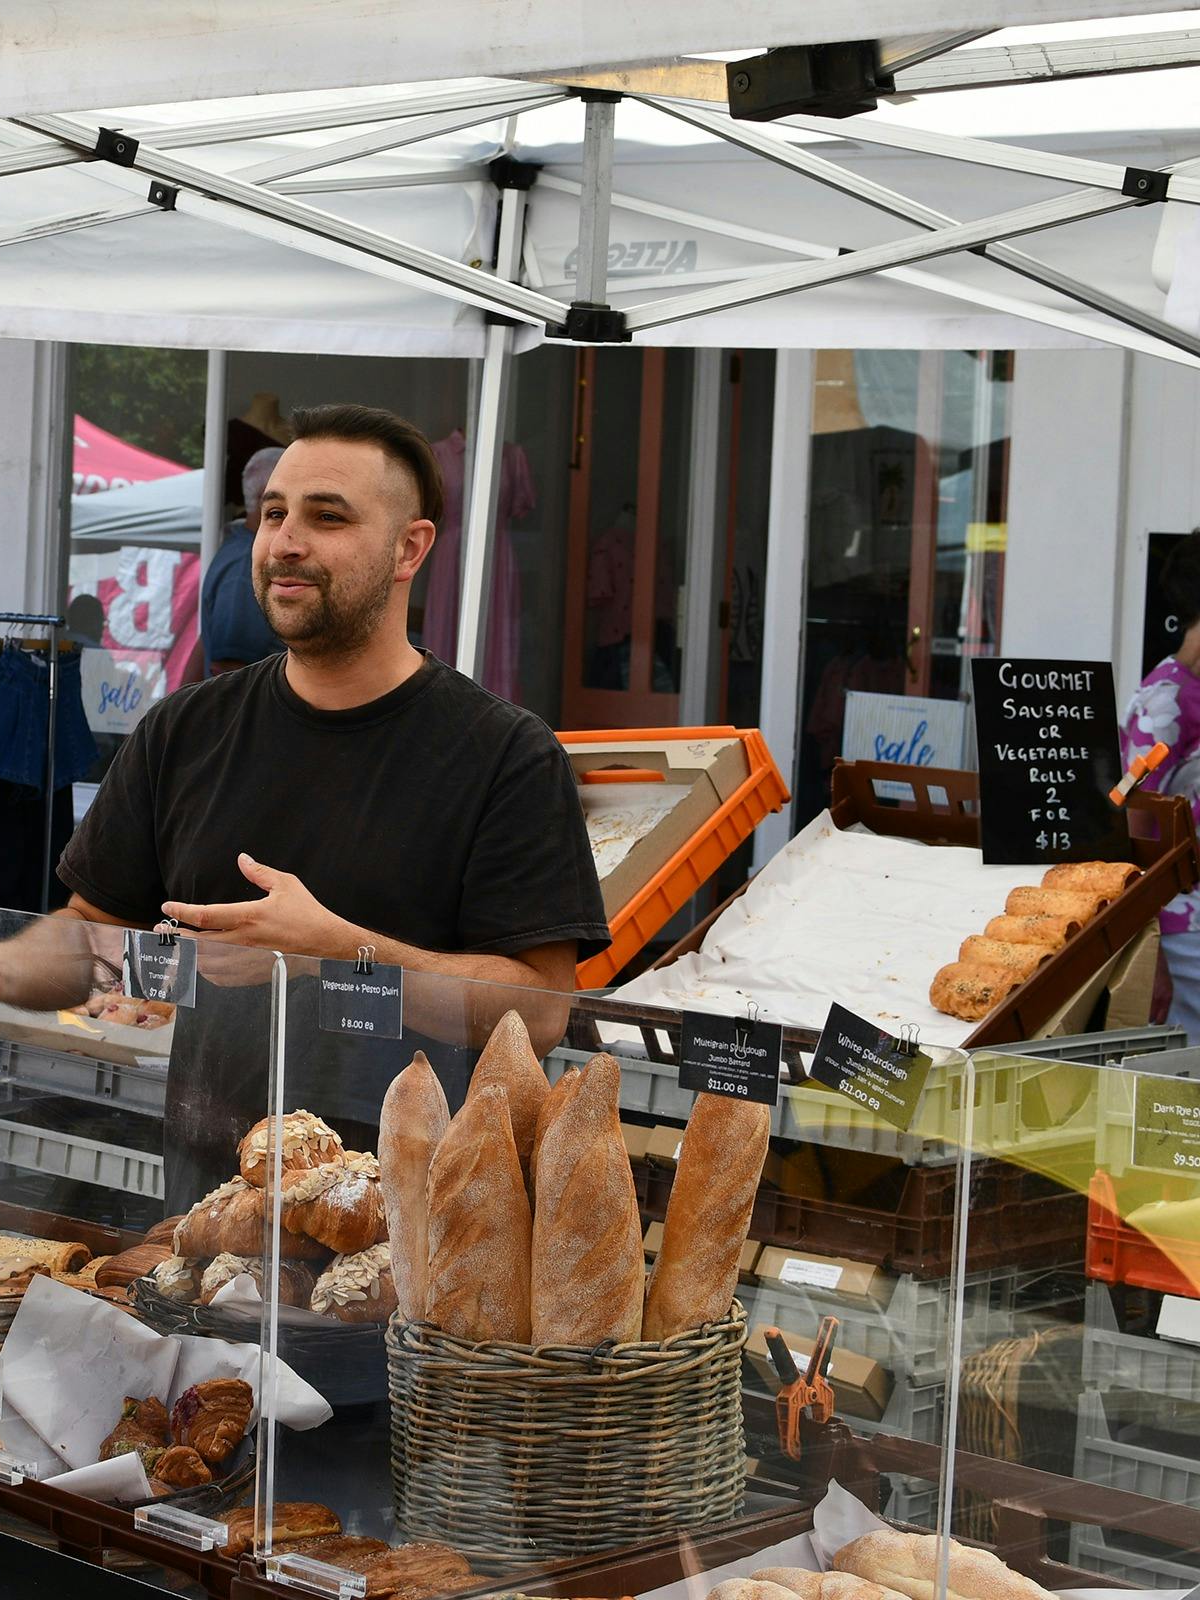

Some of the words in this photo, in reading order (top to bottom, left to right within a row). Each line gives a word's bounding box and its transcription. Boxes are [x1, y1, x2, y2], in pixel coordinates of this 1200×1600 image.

[98, 670, 143, 715] sale
[1038, 724, 1062, 739] OR
[874, 720, 935, 766] sale
[1046, 787, 1060, 804] 2
[1028, 807, 1070, 822] FOR
[1035, 830, 1071, 850] $13
[140, 953, 153, 962] Ham
[158, 956, 179, 966] Cheese
[148, 972, 170, 980] Turnover
[149, 987, 157, 997] $7
[158, 990, 166, 998] ea
[322, 980, 354, 991] Vegetable
[361, 983, 380, 994] Pesto
[381, 986, 399, 997] Swirl
[364, 1021, 373, 1031] ea
[693, 1037, 728, 1050] Multigrain
[708, 1054, 728, 1063] Jumbo
[728, 1057, 751, 1068] Battard
[837, 1032, 862, 1054] White
[862, 1048, 908, 1080] Sourdough
[846, 1057, 866, 1073] Jumbo
[707, 1078, 735, 1092] $11.00
[737, 1084, 748, 1095] ea
[839, 1079, 867, 1102] $11.00
[868, 1097, 880, 1111] ea
[1153, 1102, 1175, 1113] Dark
